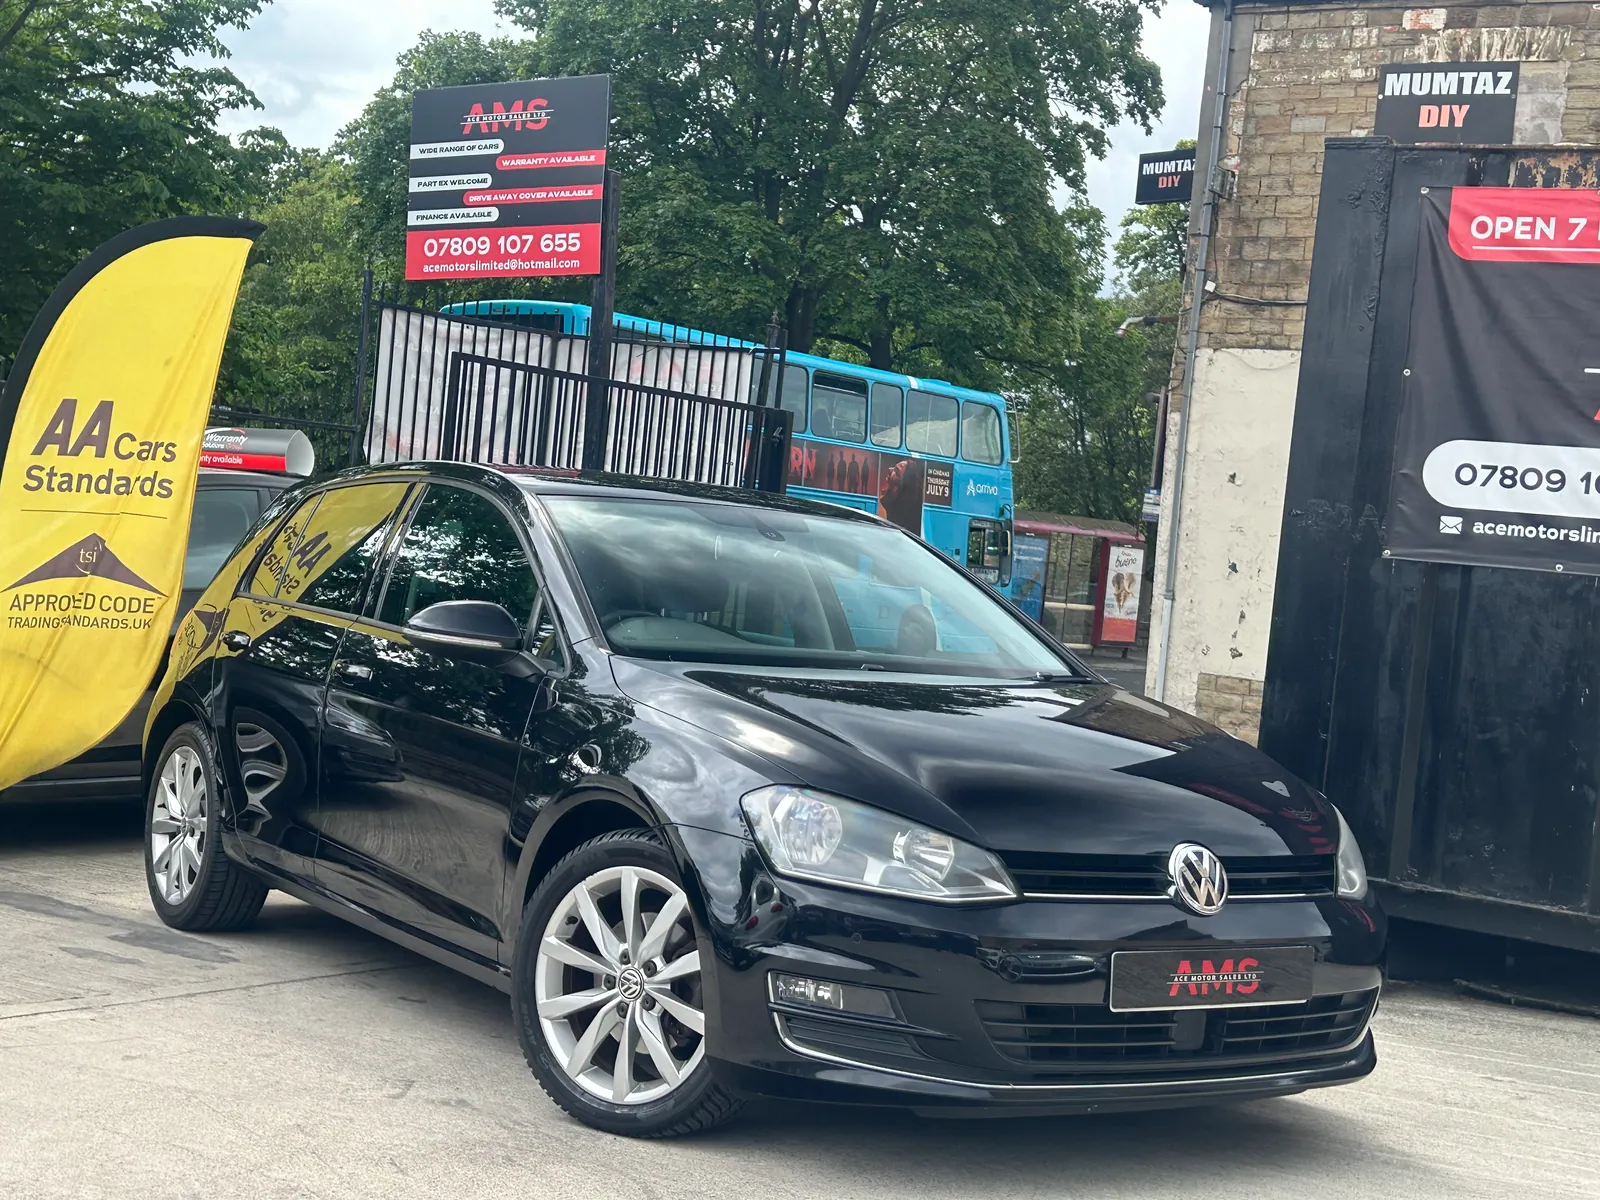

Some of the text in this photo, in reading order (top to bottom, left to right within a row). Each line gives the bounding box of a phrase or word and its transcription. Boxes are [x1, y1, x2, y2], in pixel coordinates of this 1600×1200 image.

[1384, 71, 1513, 96] MUMTAZ
[462, 97, 549, 135] AMS
[1418, 104, 1470, 128] DIY
[439, 145, 465, 153] RANGE
[501, 154, 596, 166] WARRANTY AVAILABLE
[449, 177, 488, 185] WELCOME
[1158, 175, 1181, 188] DIY
[469, 194, 492, 202] DRIVE
[519, 191, 546, 199] COVER
[548, 189, 593, 198] AVAILABLE
[416, 211, 492, 221] FINANCE AVAILABLE
[1470, 215, 1556, 241] OPEN
[1567, 217, 1588, 240] 7
[423, 232, 581, 257] 07809 107 655
[423, 258, 580, 273] acemotorslimited@hotmail.com
[30, 398, 177, 463] AA Cars
[206, 433, 248, 445] Warranty
[212, 455, 243, 464] available
[23, 464, 174, 498] Standards
[1454, 462, 1600, 495] 07809 1
[926, 485, 950, 497] JULY 9
[975, 483, 998, 496] arriva
[79, 547, 97, 563] tsi
[99, 595, 155, 614] CODE
[1168, 957, 1259, 997] AMS
[1219, 973, 1242, 981] SALES
